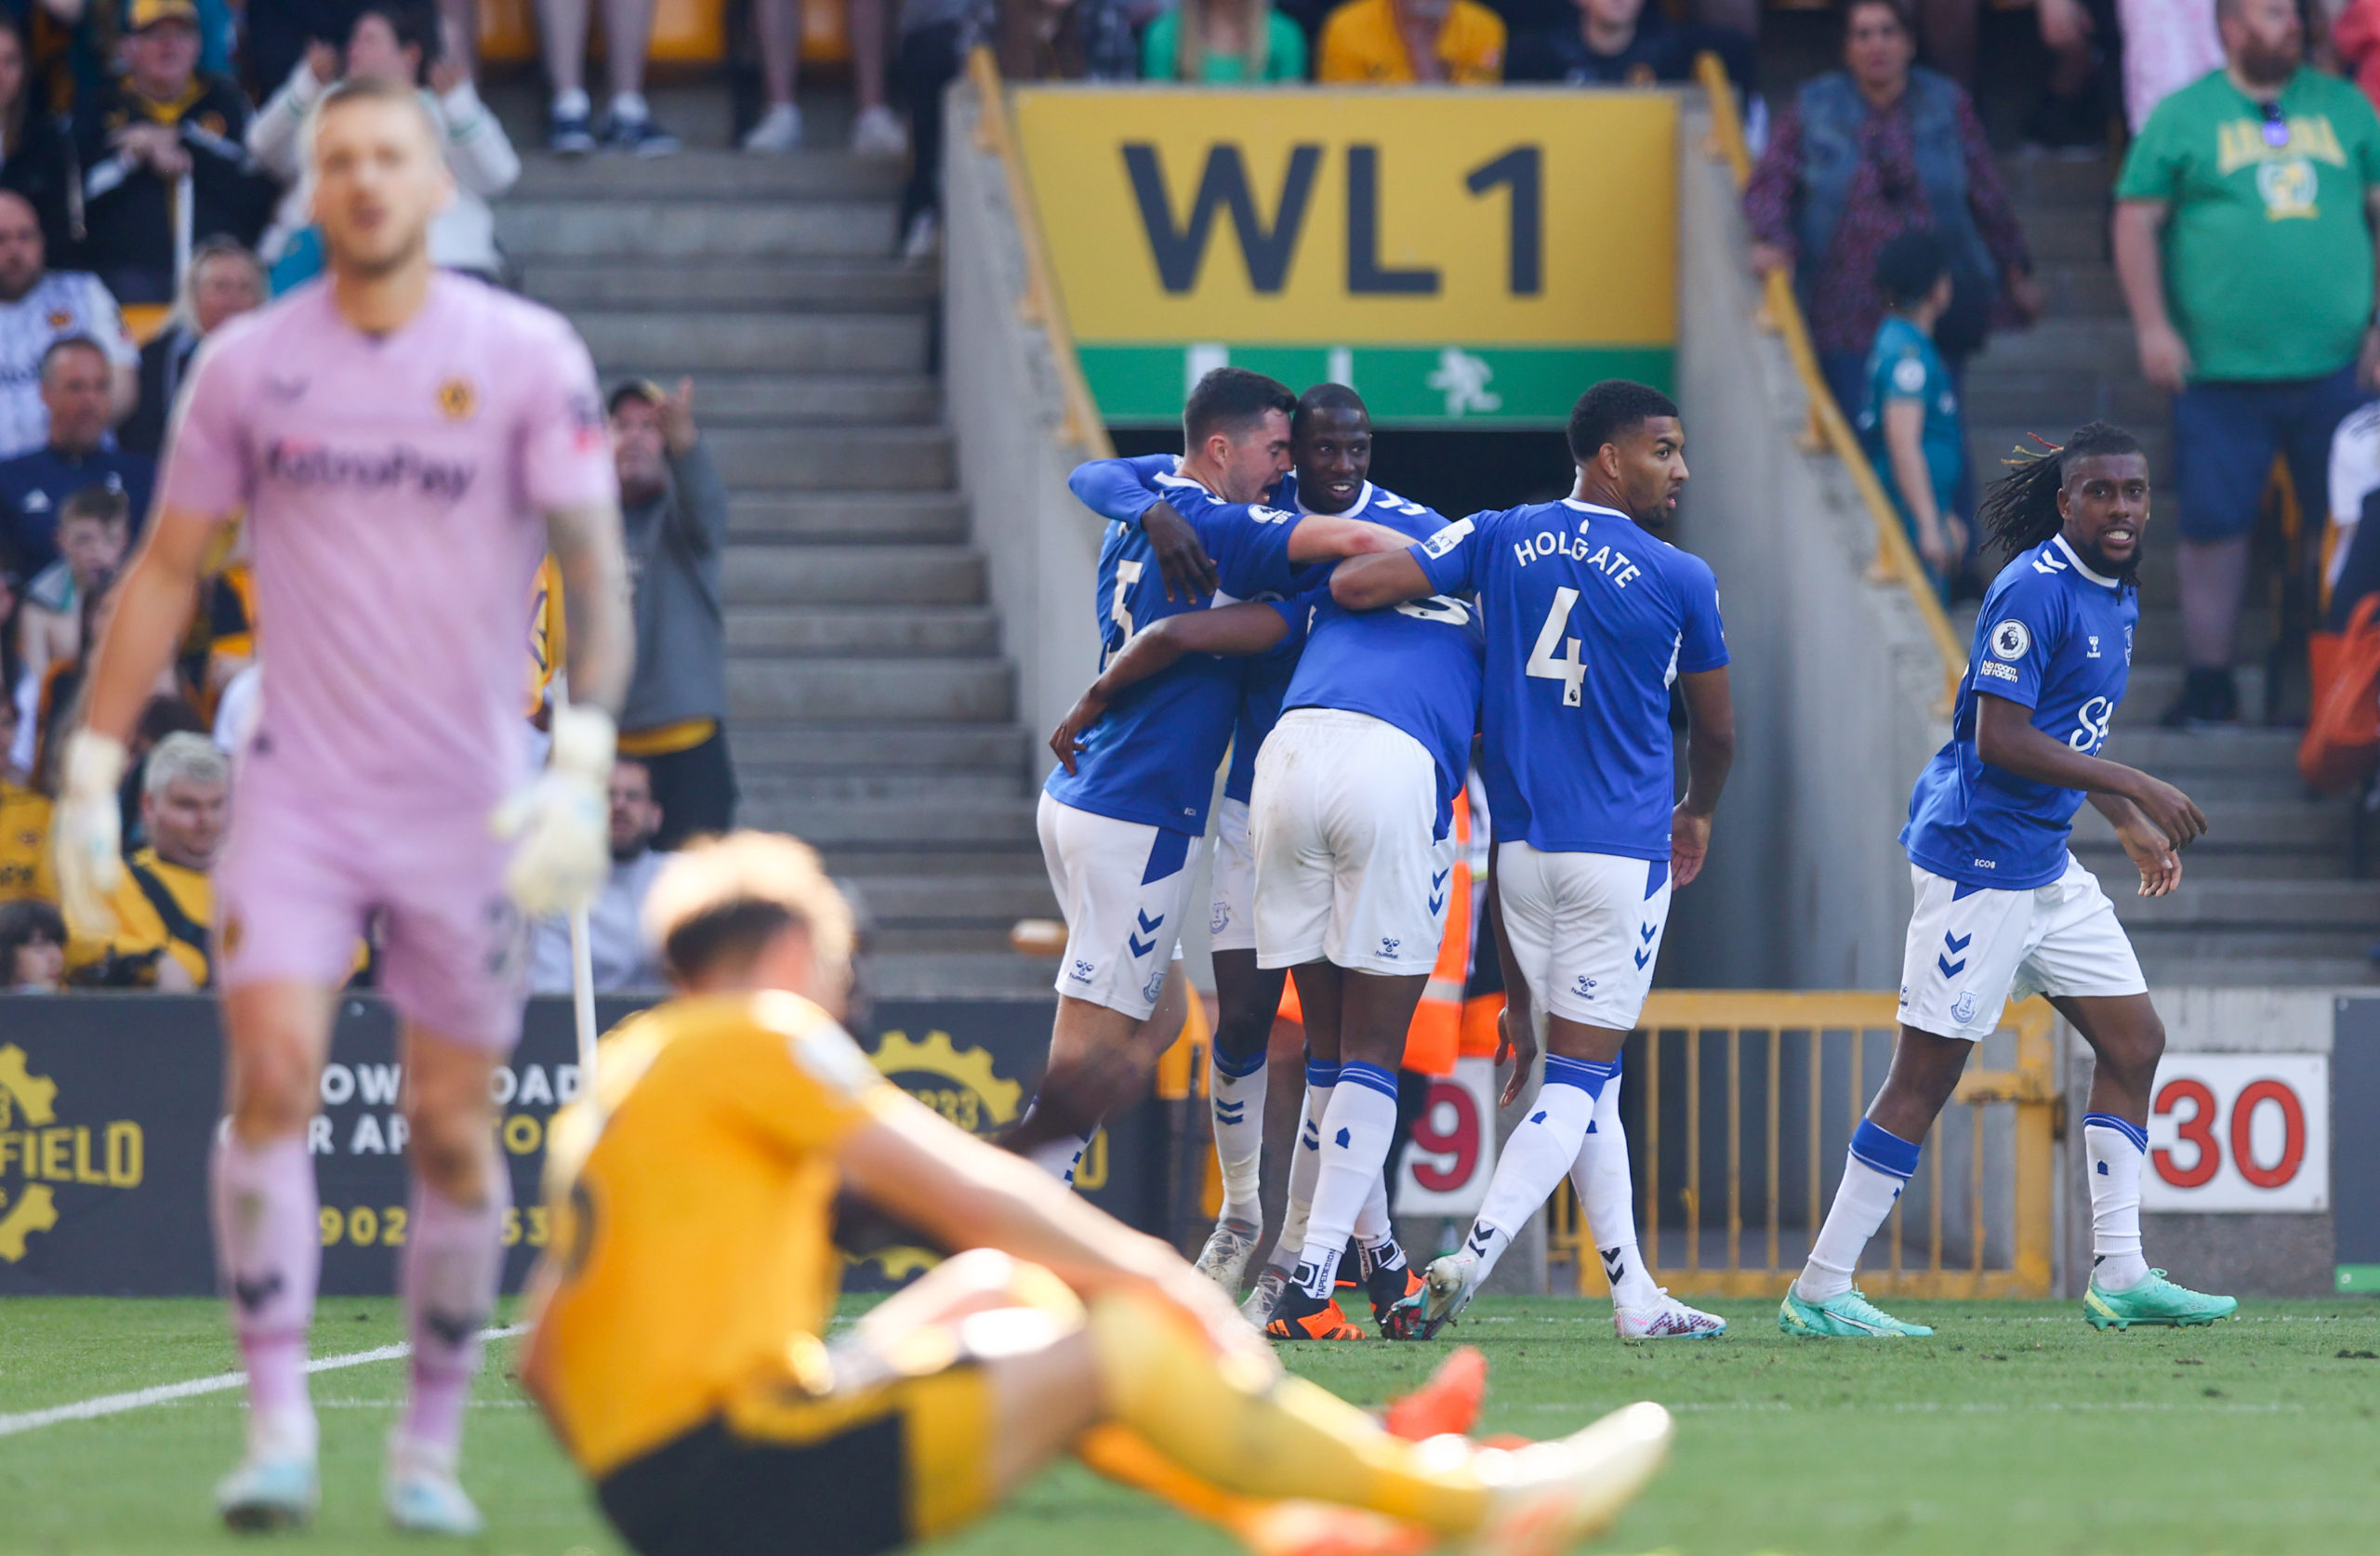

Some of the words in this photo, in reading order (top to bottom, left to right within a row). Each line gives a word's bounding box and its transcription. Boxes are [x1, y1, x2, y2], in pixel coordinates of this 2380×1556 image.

[1120, 141, 1545, 297] WL1
[1514, 531, 1642, 589] HOLGATE
[1525, 586, 1588, 707] 4
[1410, 1081, 1481, 1193] 9
[2150, 1078, 2306, 1189] 30
